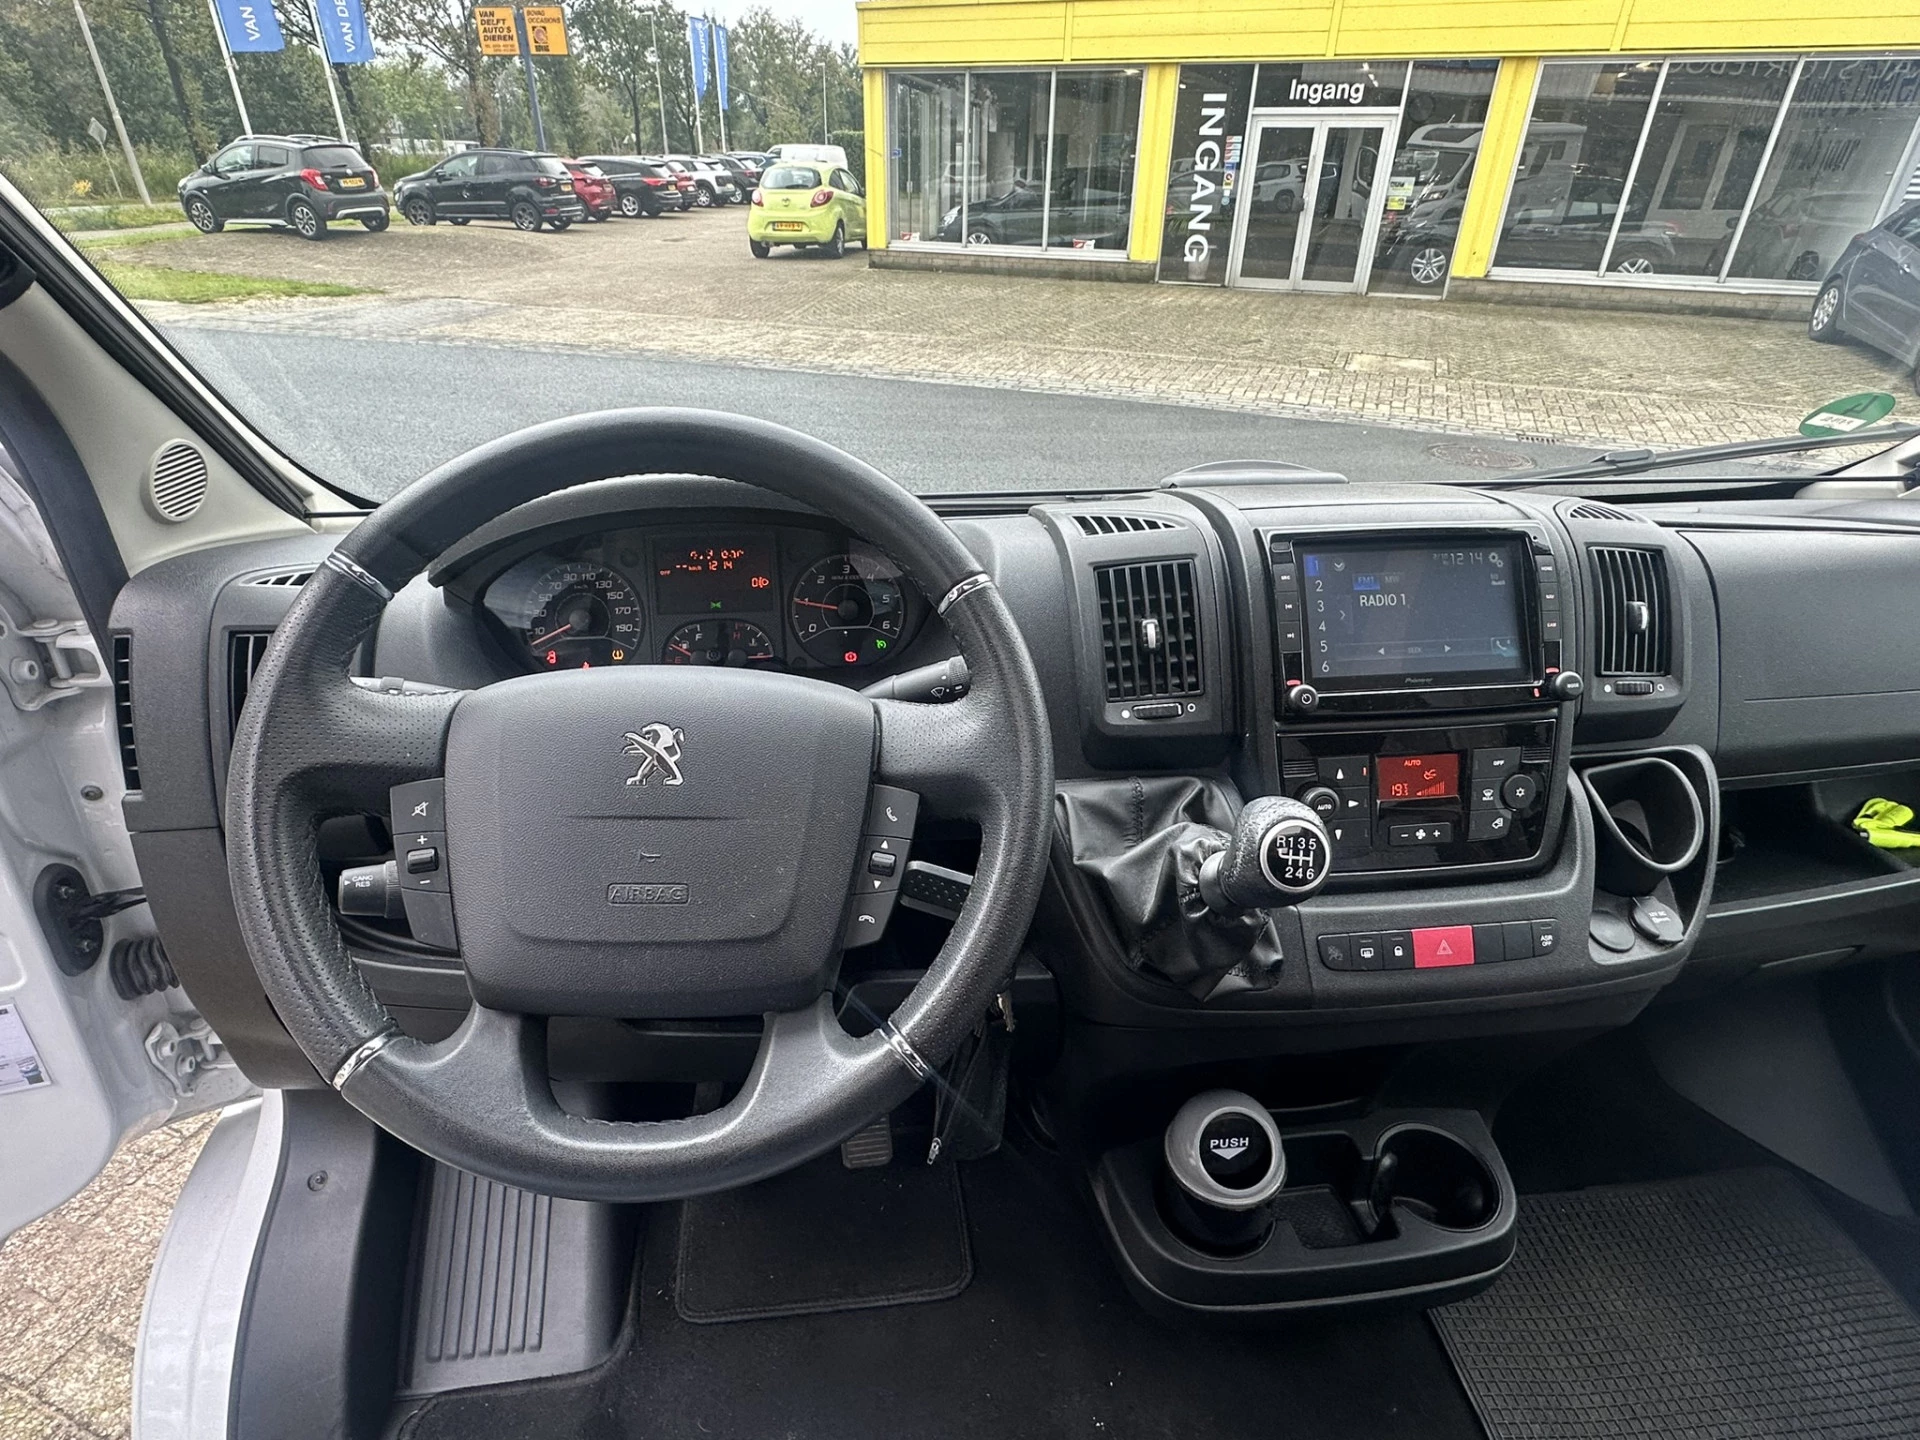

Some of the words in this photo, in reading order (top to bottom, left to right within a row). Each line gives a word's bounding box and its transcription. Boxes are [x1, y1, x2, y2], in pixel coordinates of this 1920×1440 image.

[240, 6, 261, 41] VAN
[339, 21, 356, 53] VAN
[1289, 79, 1365, 104] Ingang
[1184, 93, 1228, 262] INGANG
[843, 565, 850, 573] 3
[563, 573, 577, 581] 90
[817, 575, 825, 583] 2
[867, 573, 874, 581] 4
[595, 580, 613, 588] 130
[1315, 580, 1323, 592] 2
[606, 591, 624, 600] 150
[882, 594, 890, 603] 5
[1360, 594, 1397, 607] RADIO
[1400, 593, 1406, 605] 1
[1317, 600, 1324, 612] 3
[615, 624, 633, 632] 190
[808, 623, 817, 632] 0
[882, 620, 890, 629] 6
[1319, 621, 1326, 632] 4
[696, 633, 703, 641] F
[733, 632, 742, 640] H
[1320, 641, 1328, 653] 5
[1322, 661, 1330, 673] 6
[1404, 759, 1421, 767] AUTO
[1276, 835, 1286, 847] R
[1288, 837, 1293, 848] 1
[1297, 837, 1306, 849] 3
[1308, 838, 1317, 850] 5
[1285, 866, 1294, 878] 2
[1295, 868, 1304, 879] 4
[1306, 868, 1315, 879] 6
[610, 887, 682, 901] AIRBAG
[1210, 1137, 1249, 1149] PUSH
